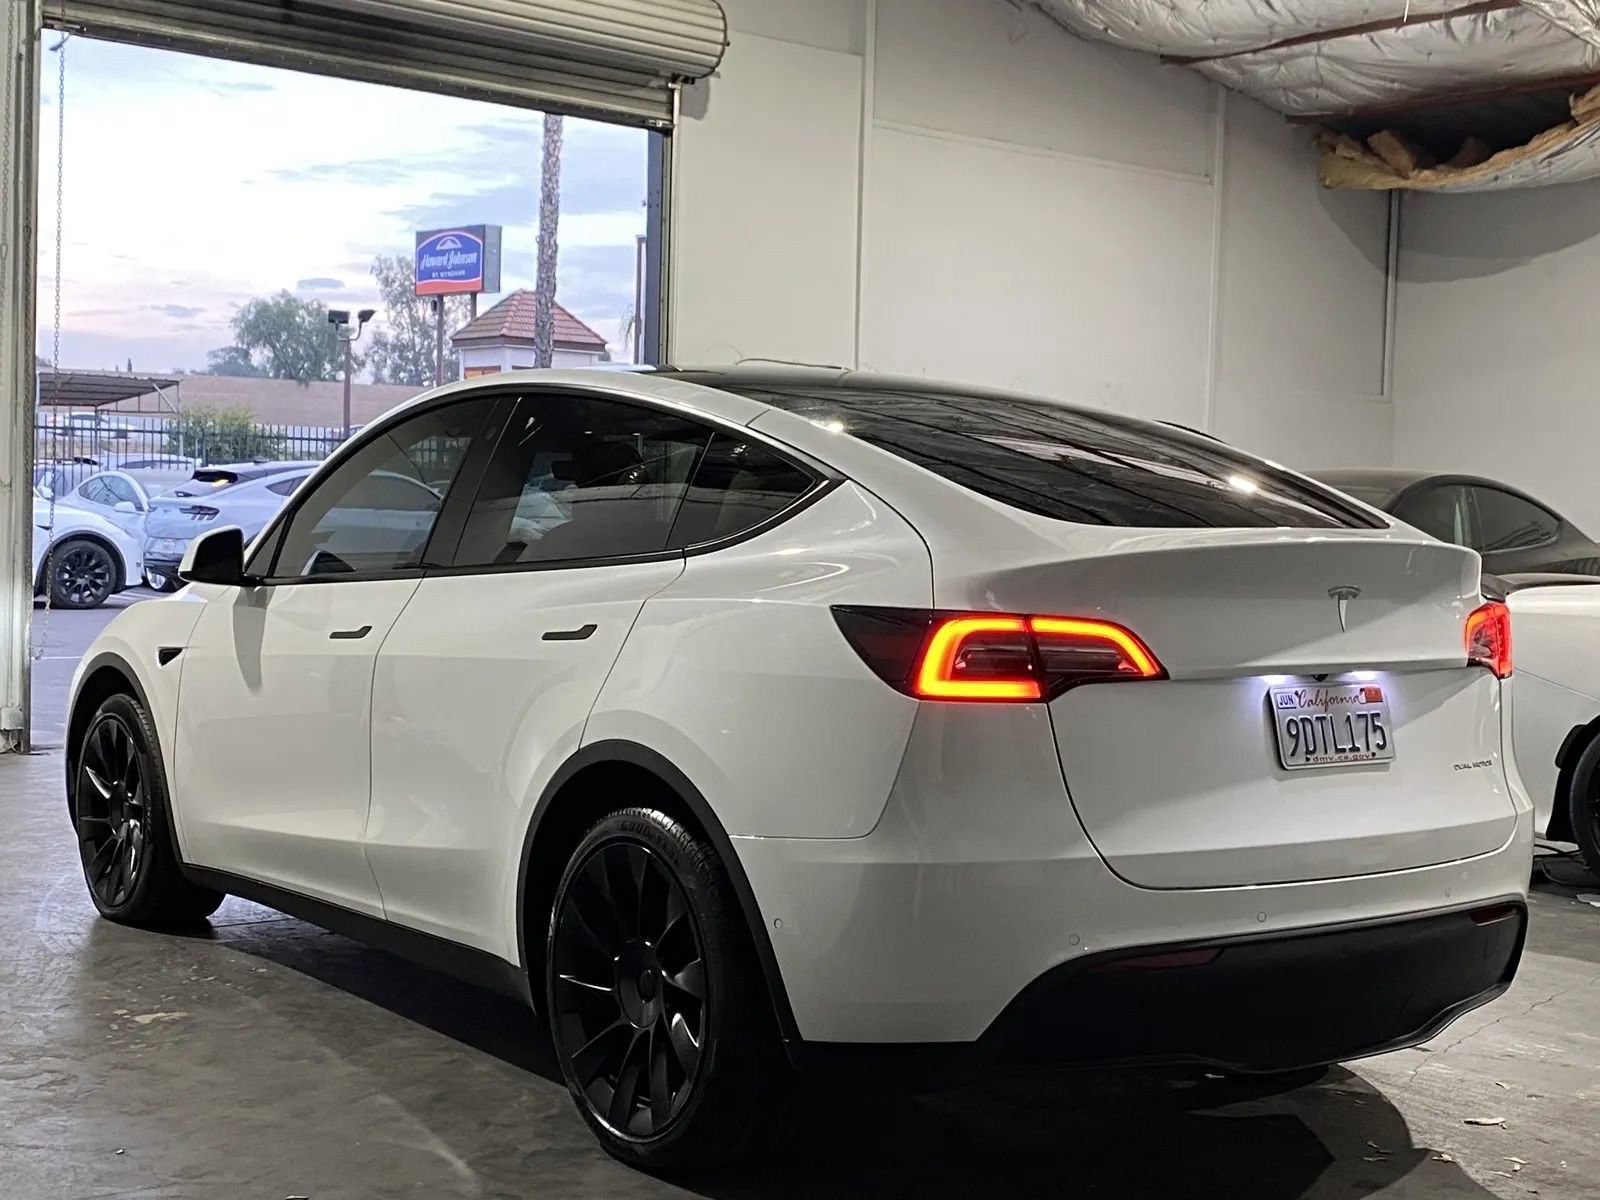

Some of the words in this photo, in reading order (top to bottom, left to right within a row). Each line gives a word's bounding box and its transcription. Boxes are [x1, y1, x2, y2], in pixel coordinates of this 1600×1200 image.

[420, 253, 448, 270] Howard
[447, 250, 477, 269] Johnson
[1279, 693, 1294, 706] JUN
[1297, 688, 1366, 713] California
[1286, 712, 1387, 757] 9DTL175
[1312, 754, 1370, 763] dmv.ca.gov
